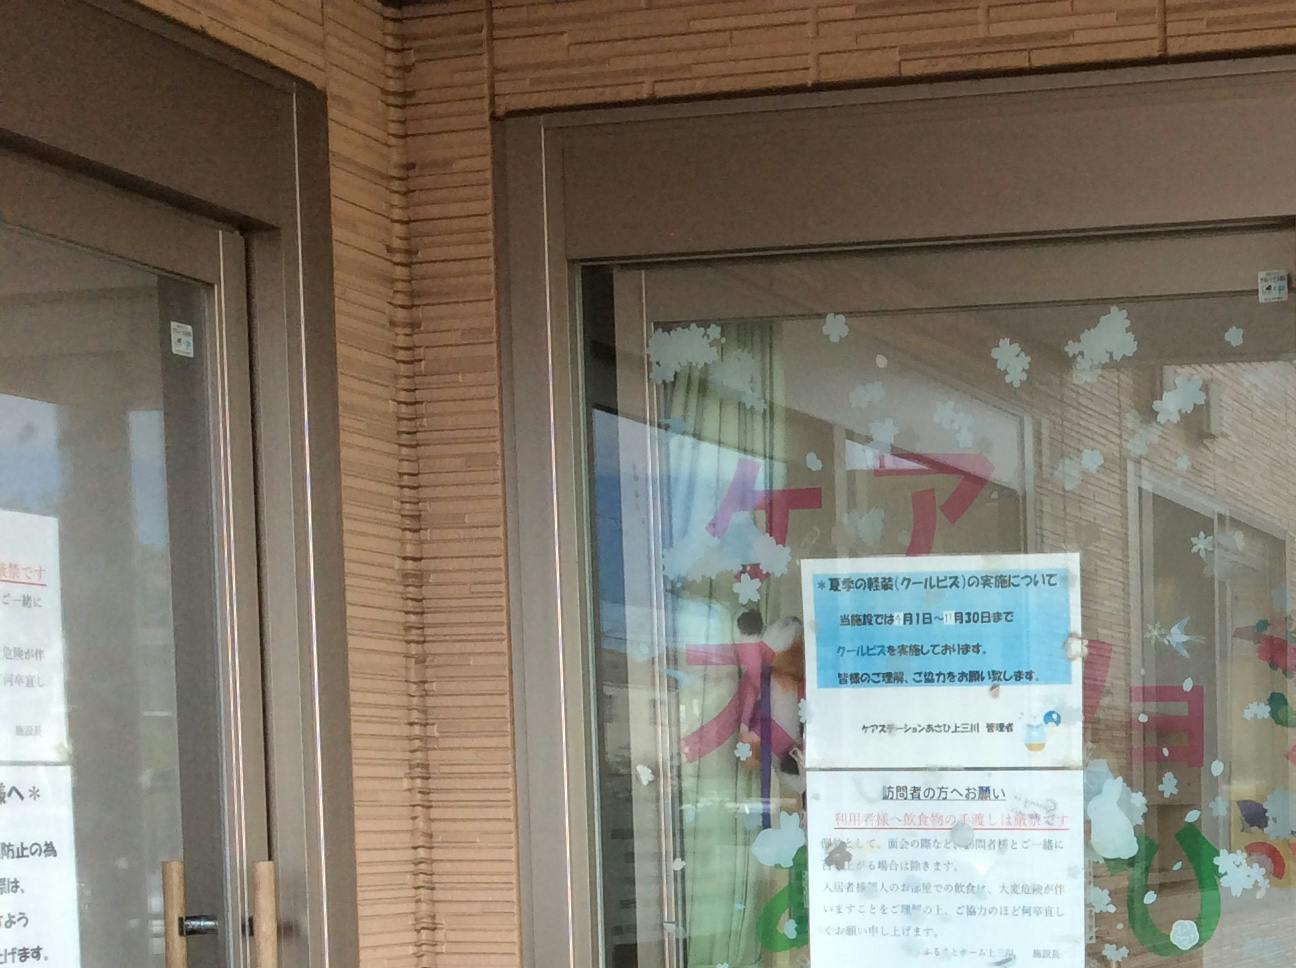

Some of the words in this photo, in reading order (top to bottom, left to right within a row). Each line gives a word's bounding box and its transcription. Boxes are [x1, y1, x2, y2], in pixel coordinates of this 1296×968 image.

[882, 785, 1007, 800] 訪問者の方へお願い
